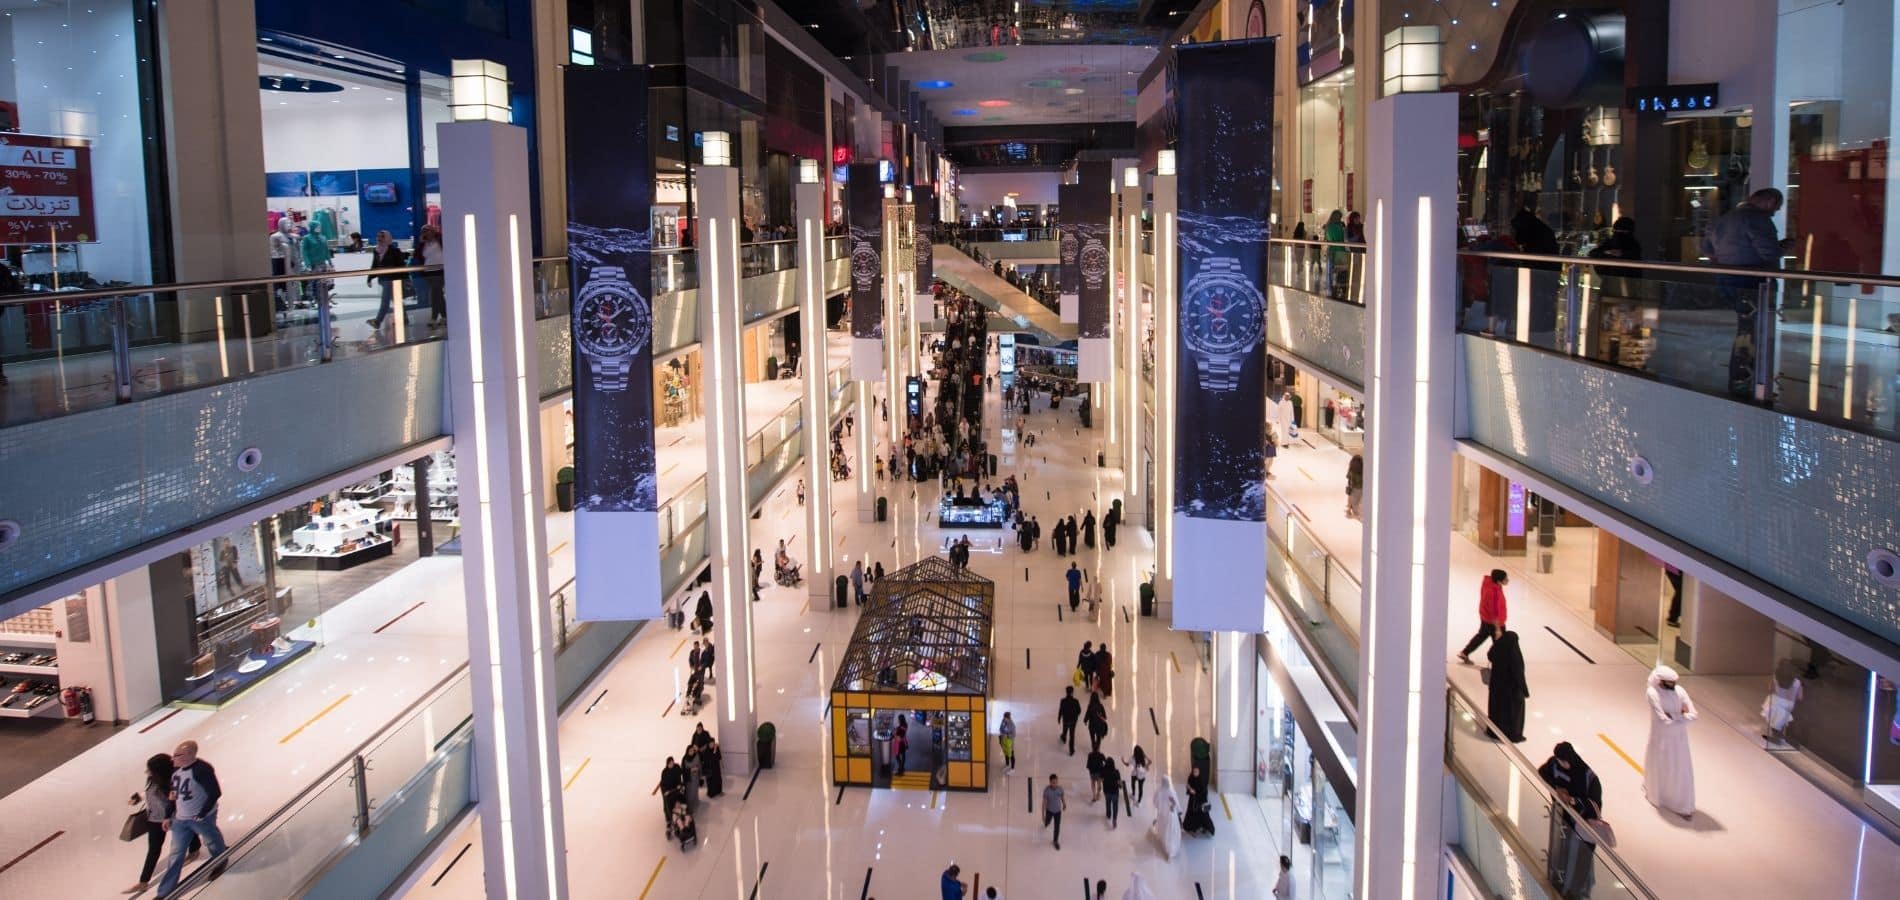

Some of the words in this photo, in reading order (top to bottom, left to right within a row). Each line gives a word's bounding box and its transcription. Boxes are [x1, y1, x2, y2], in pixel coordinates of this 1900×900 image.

[23, 150, 65, 165] ALE
[5, 170, 32, 179] 30%
[43, 171, 69, 181] 70%
[7, 197, 70, 214] تنزيلات
